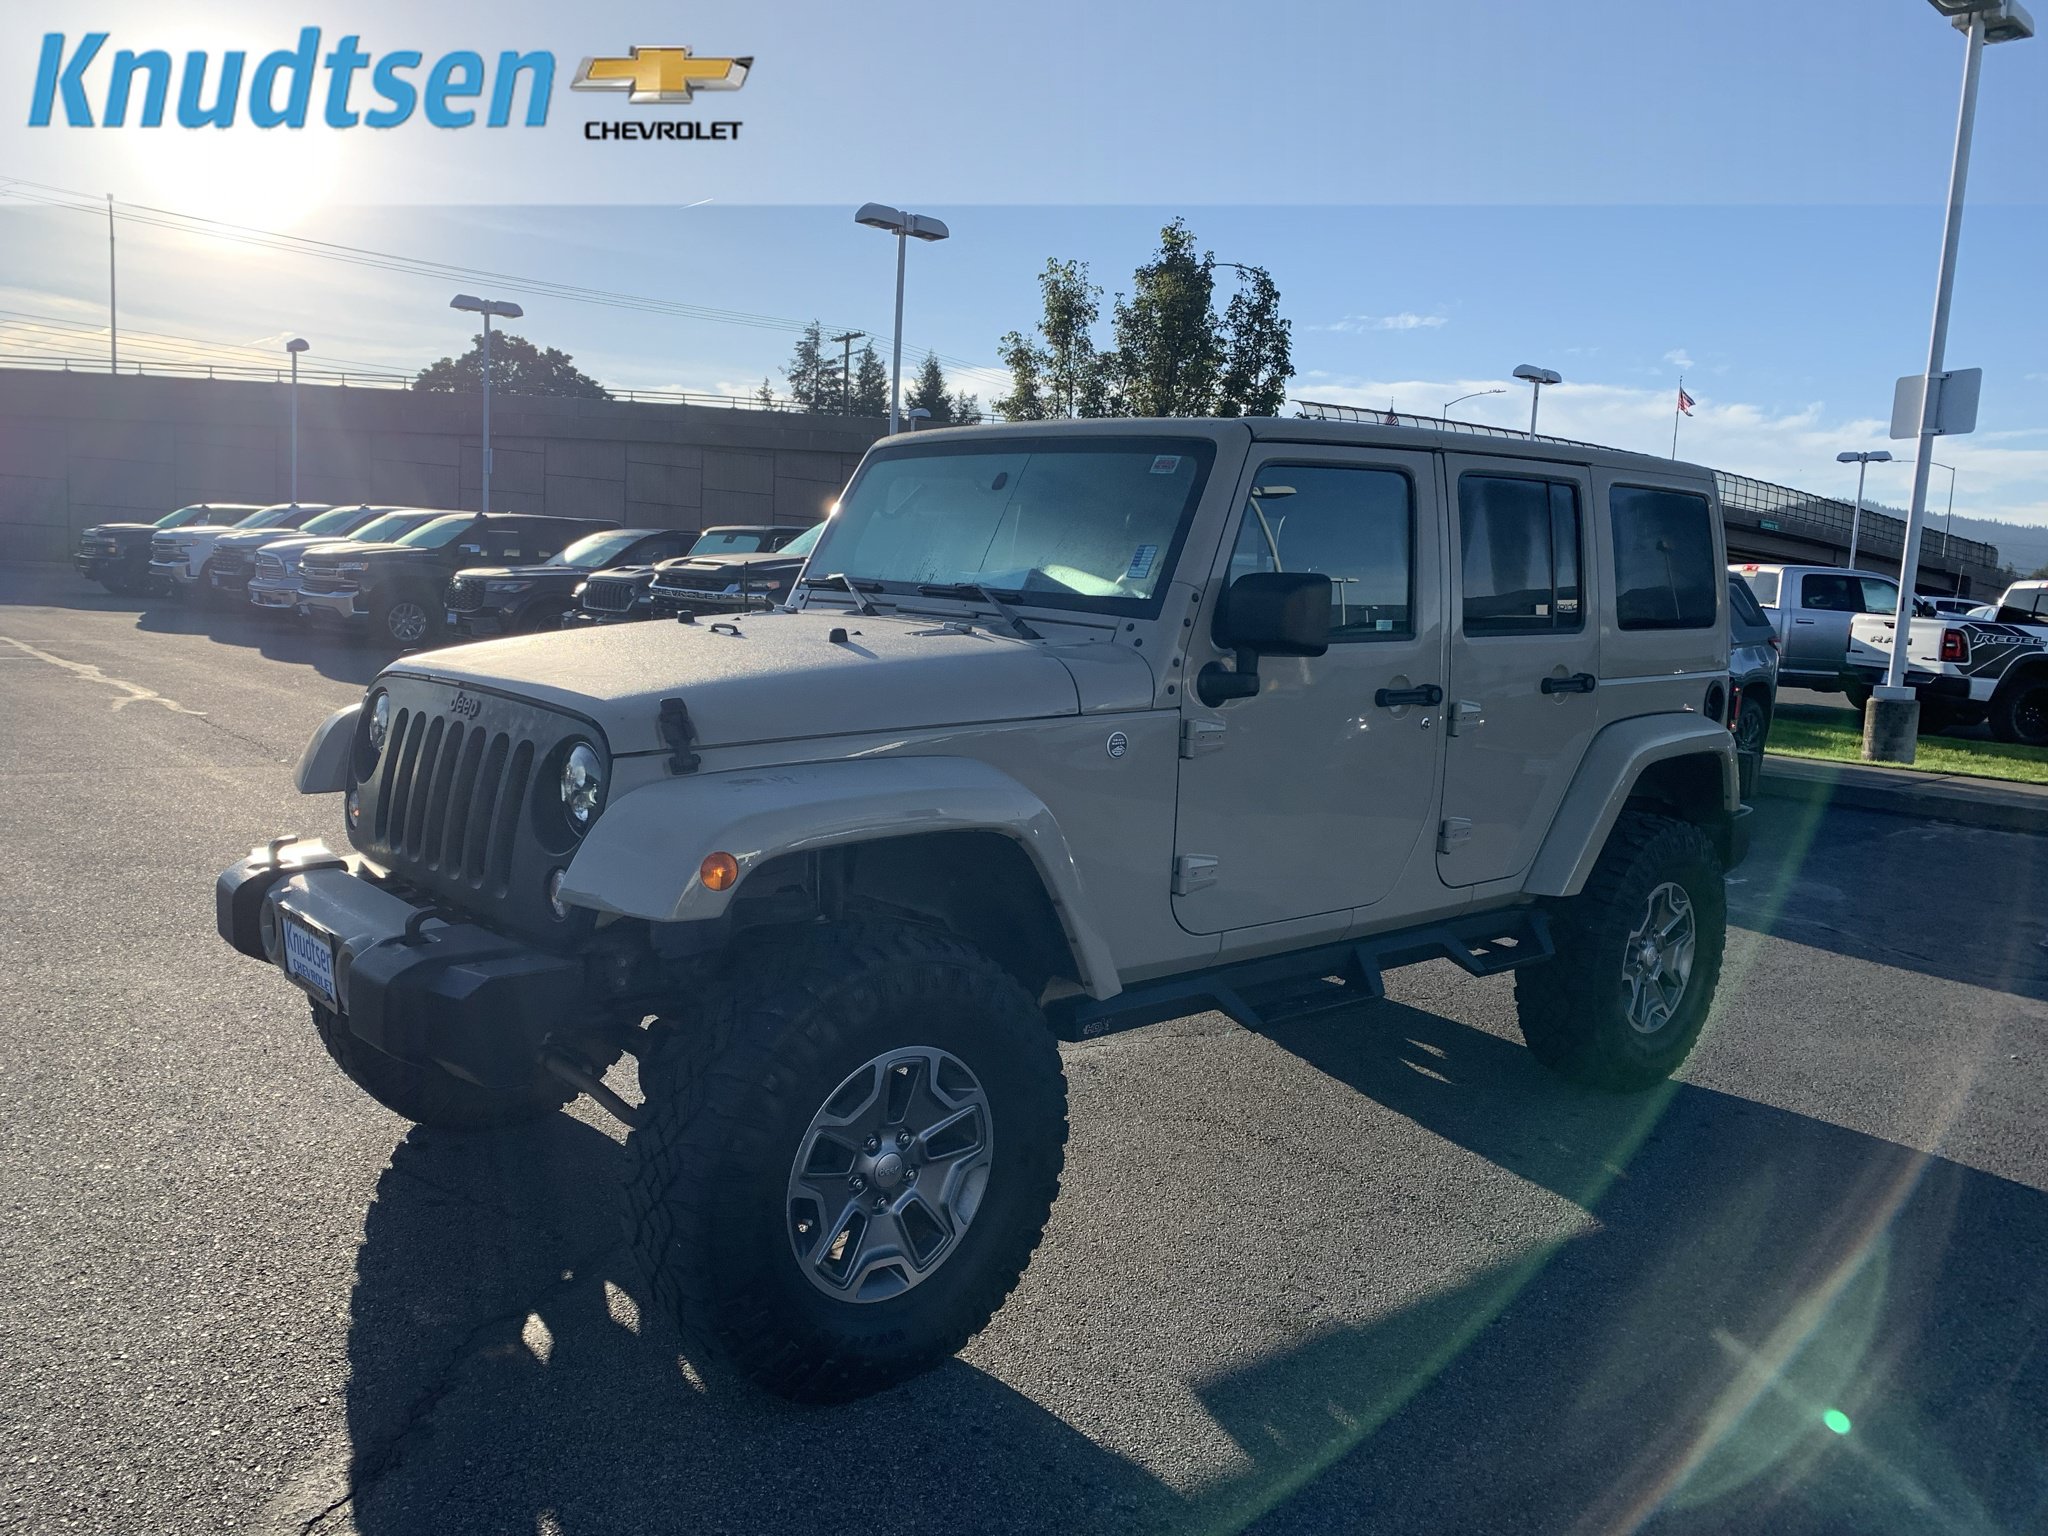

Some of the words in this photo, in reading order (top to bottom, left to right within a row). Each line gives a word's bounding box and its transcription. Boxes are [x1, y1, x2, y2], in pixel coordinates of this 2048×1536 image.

[650, 587, 725, 601] CHEVROLET
[1974, 632, 2048, 647] REBEL
[448, 691, 480, 720] Jeep
[293, 959, 333, 994] CHEVROLET
